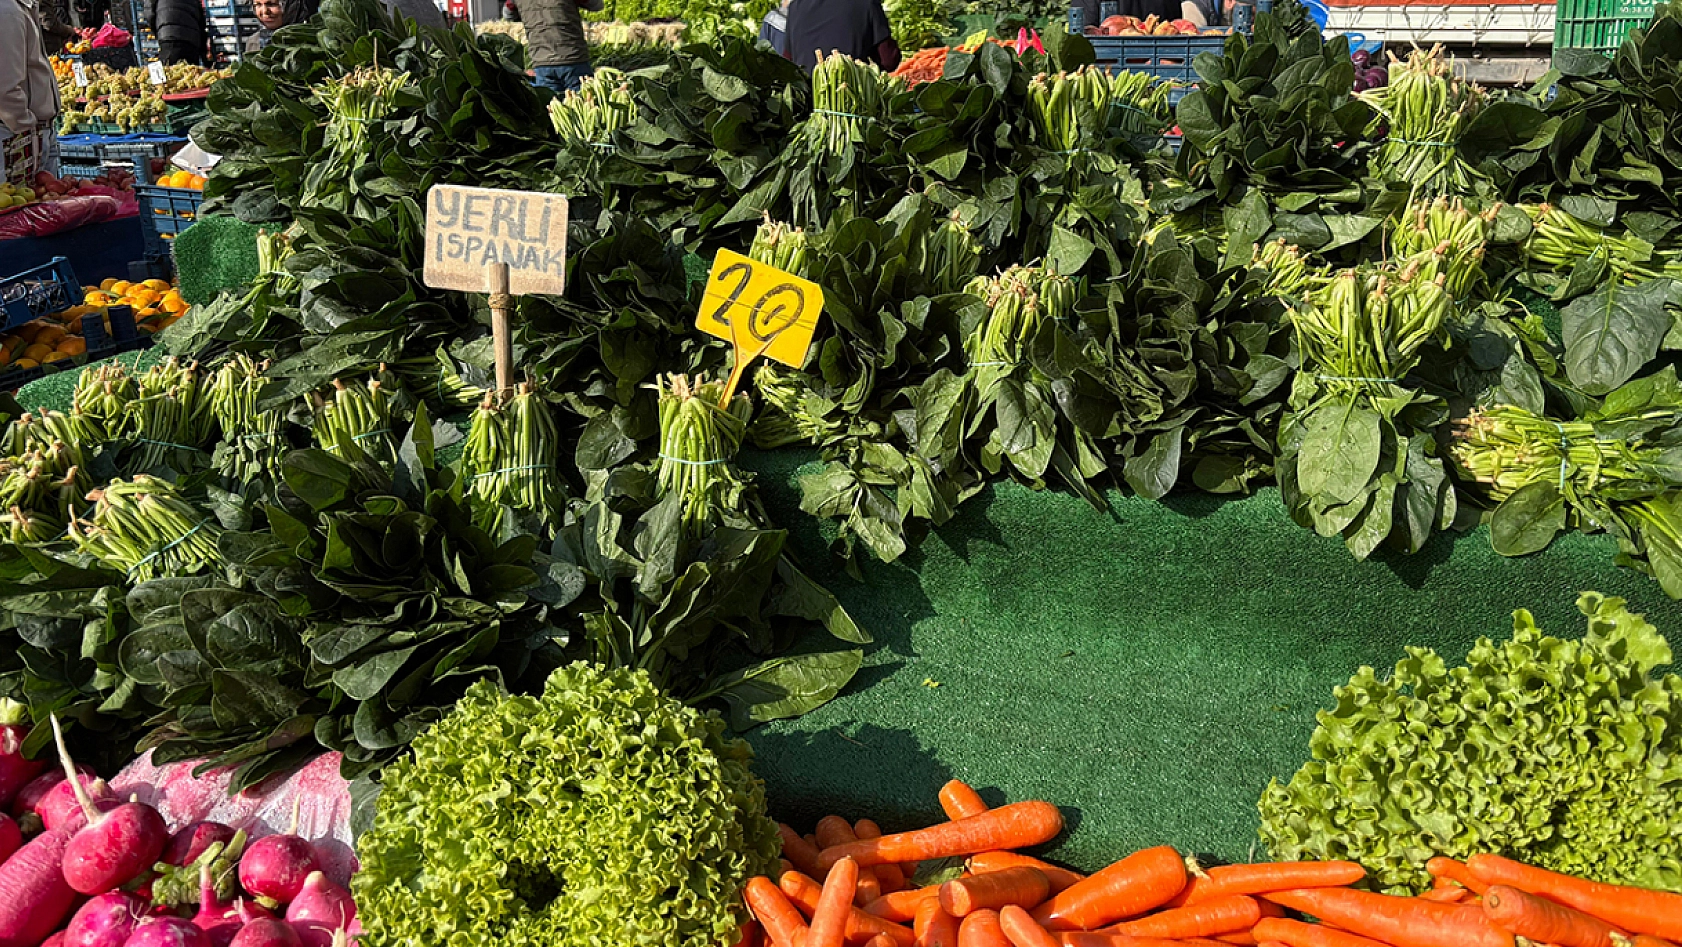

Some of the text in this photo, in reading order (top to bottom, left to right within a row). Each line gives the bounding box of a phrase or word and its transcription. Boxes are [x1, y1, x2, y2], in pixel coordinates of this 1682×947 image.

[435, 189, 553, 246] YERLİ
[435, 233, 563, 276] ISPANAK
[711, 262, 805, 341] 20
